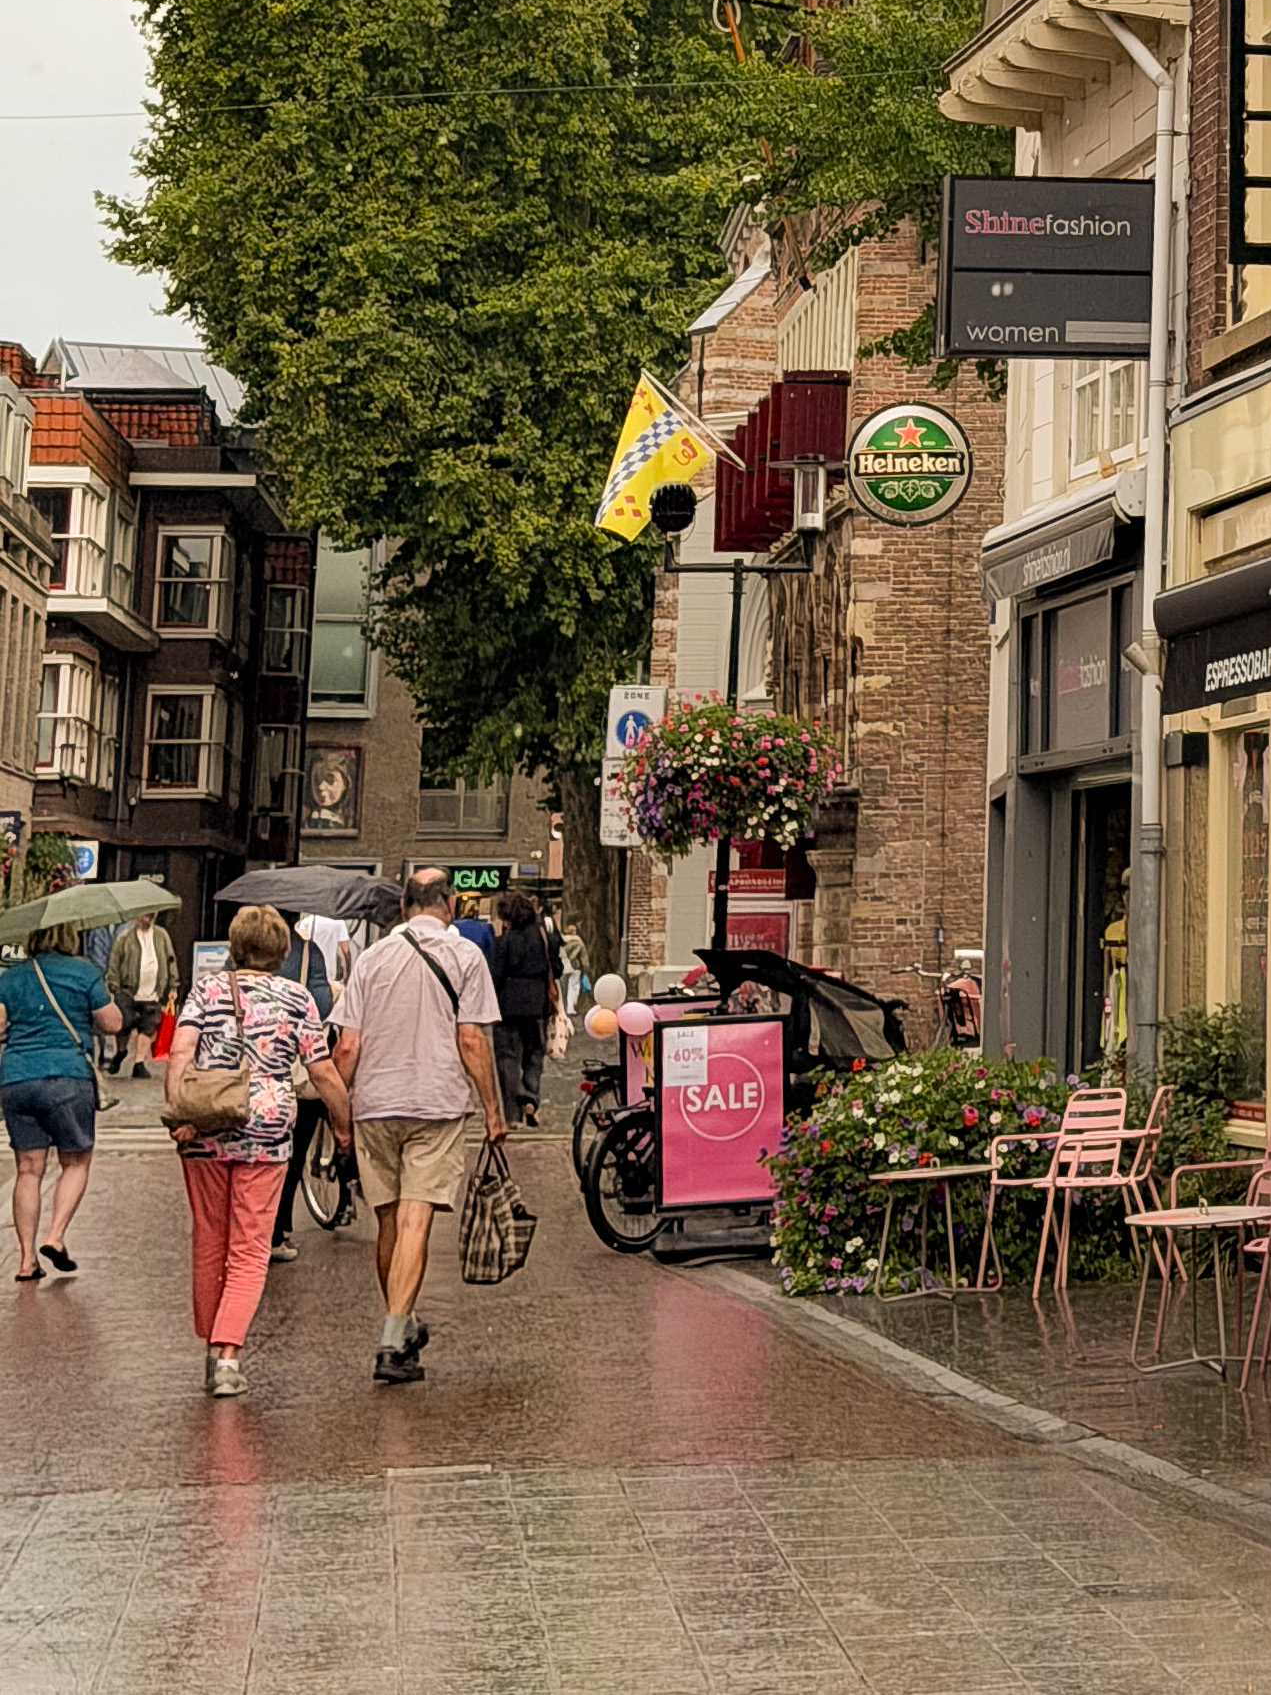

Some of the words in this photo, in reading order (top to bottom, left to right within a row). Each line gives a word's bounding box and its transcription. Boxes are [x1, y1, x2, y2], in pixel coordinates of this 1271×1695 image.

[964, 209, 1132, 237] Shinefashion
[966, 323, 1060, 343] women
[858, 453, 962, 474] Heineken
[623, 691, 650, 700] ZONE
[686, 1082, 759, 1113] SALE
